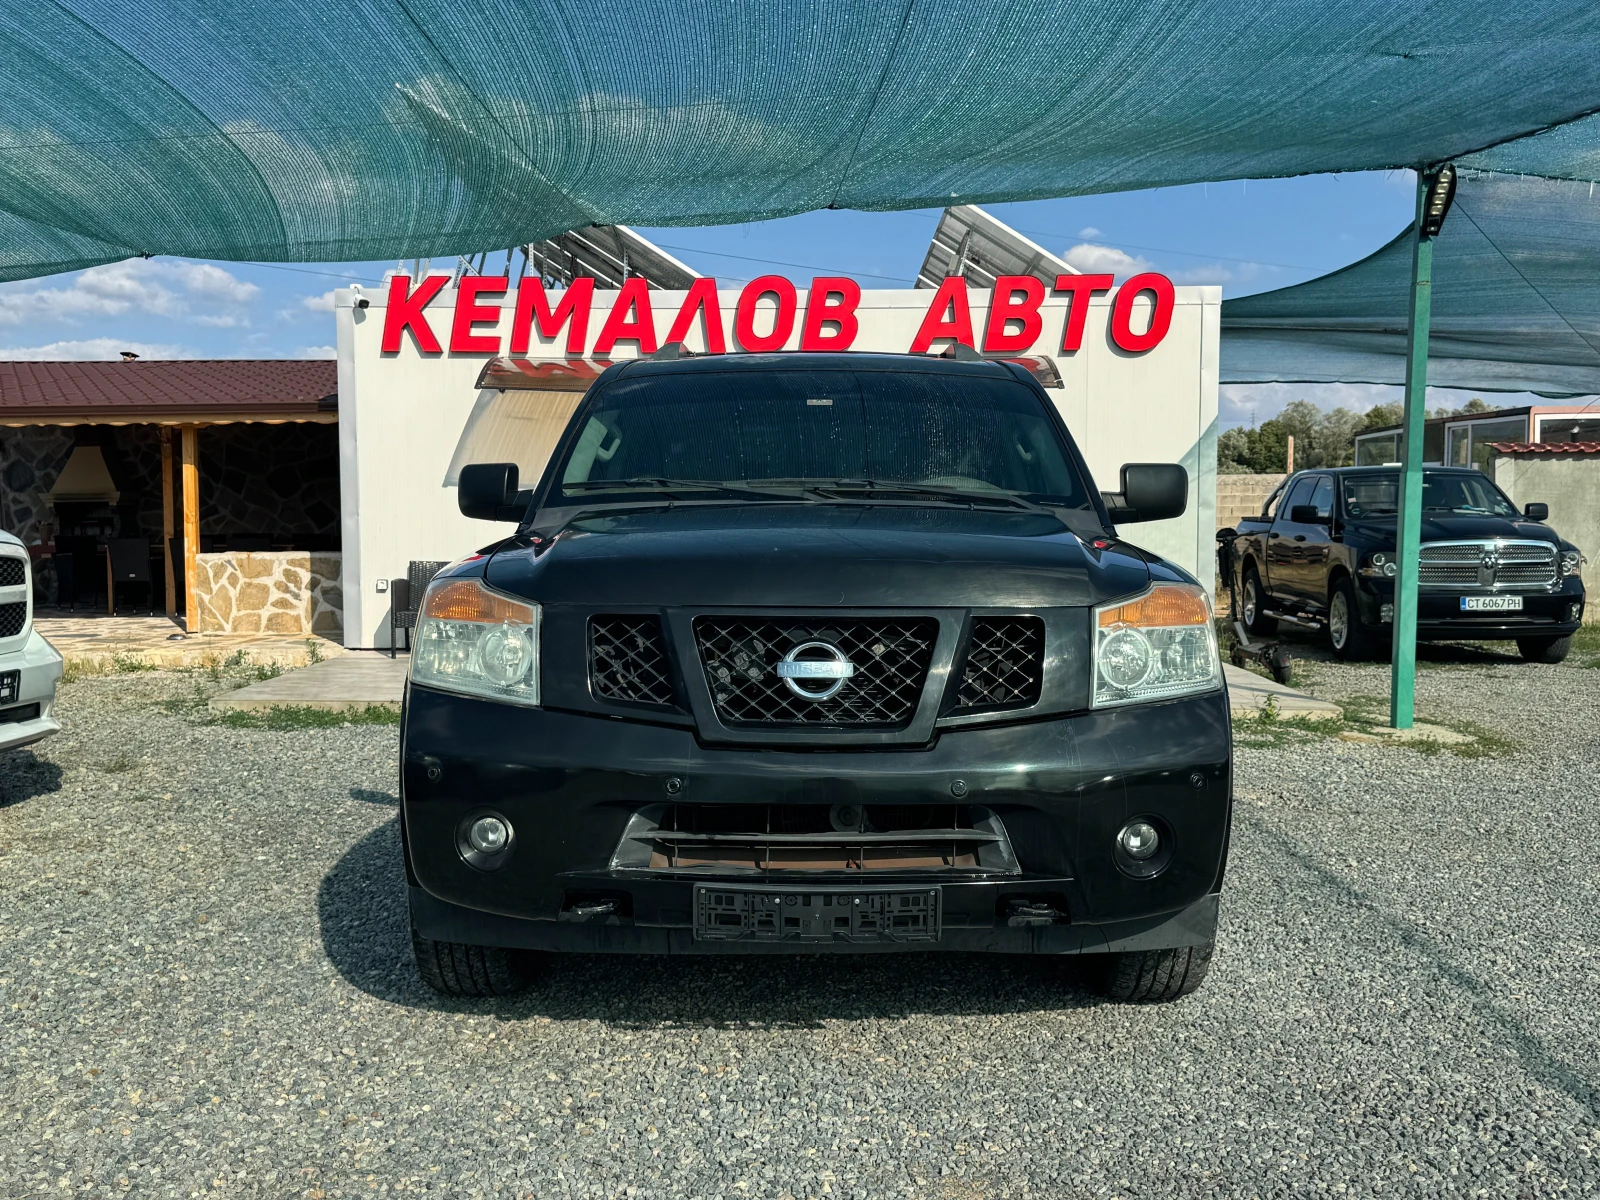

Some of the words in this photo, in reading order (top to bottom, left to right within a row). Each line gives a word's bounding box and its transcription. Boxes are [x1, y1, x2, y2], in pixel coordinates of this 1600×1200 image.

[381, 275, 862, 354] КЕМАЛОВ
[909, 272, 1177, 353] АВТО
[1467, 598, 1481, 609] CT
[1482, 598, 1506, 609] 6067
[1507, 598, 1521, 609] PH
[784, 663, 845, 675] NISSAN
